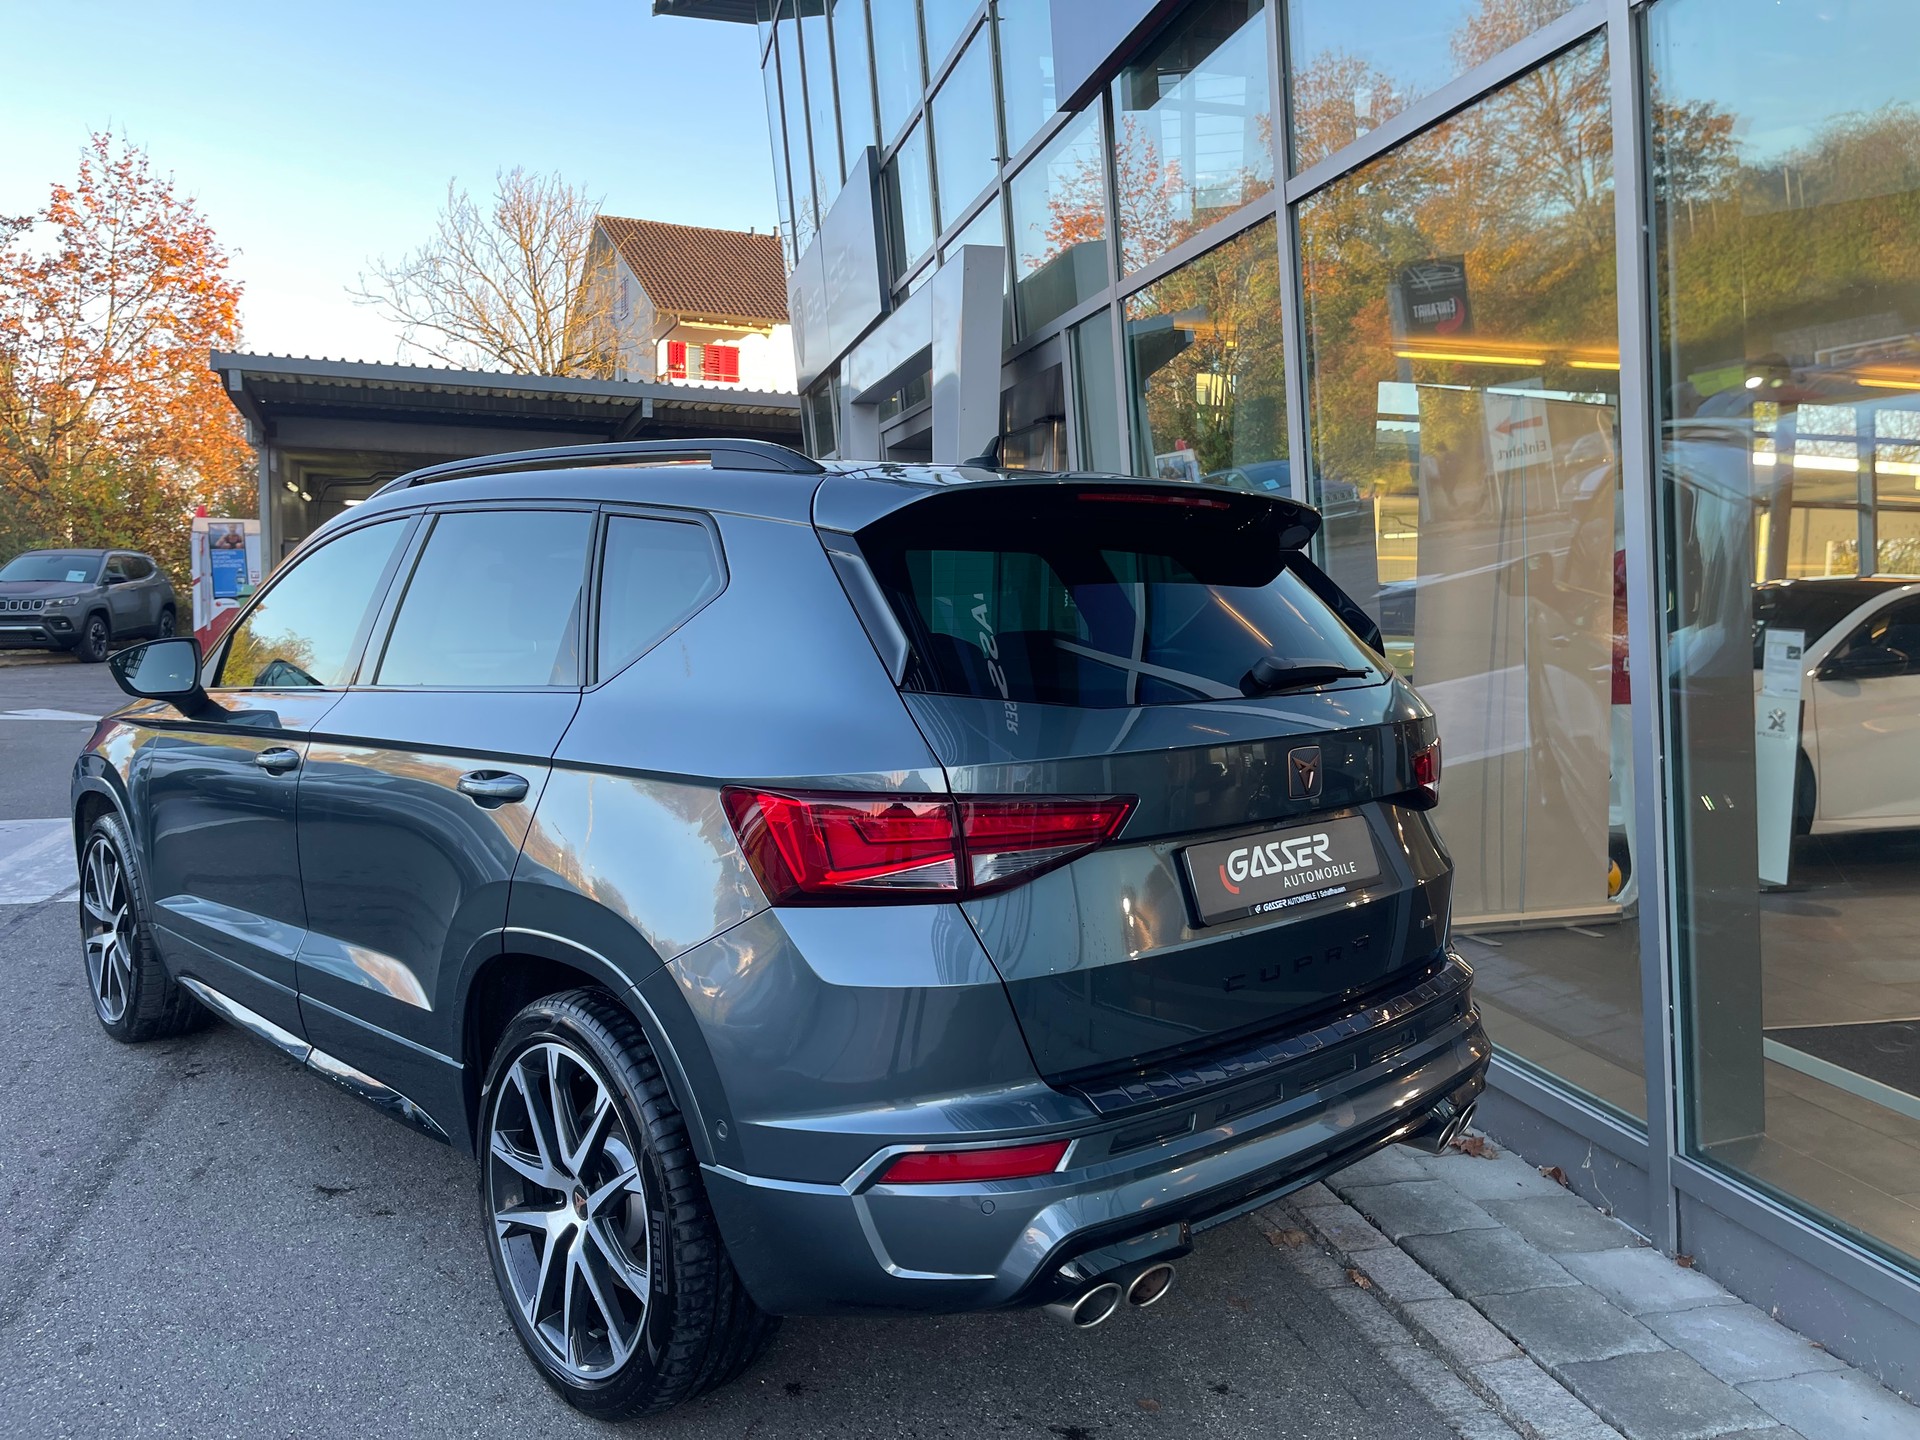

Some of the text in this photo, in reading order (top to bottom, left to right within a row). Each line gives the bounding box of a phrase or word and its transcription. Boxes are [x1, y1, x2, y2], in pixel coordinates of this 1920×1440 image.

[1227, 833, 1332, 882] GASSER
[1283, 861, 1357, 888] AUTOMOBILE
[1263, 899, 1287, 912] GASSER
[1287, 892, 1317, 906] AUTOMOBILE
[1320, 886, 1347, 898] Schaffhausen
[1223, 934, 1370, 993] CUPRA
[652, 1210, 669, 1295] PIRELLI
